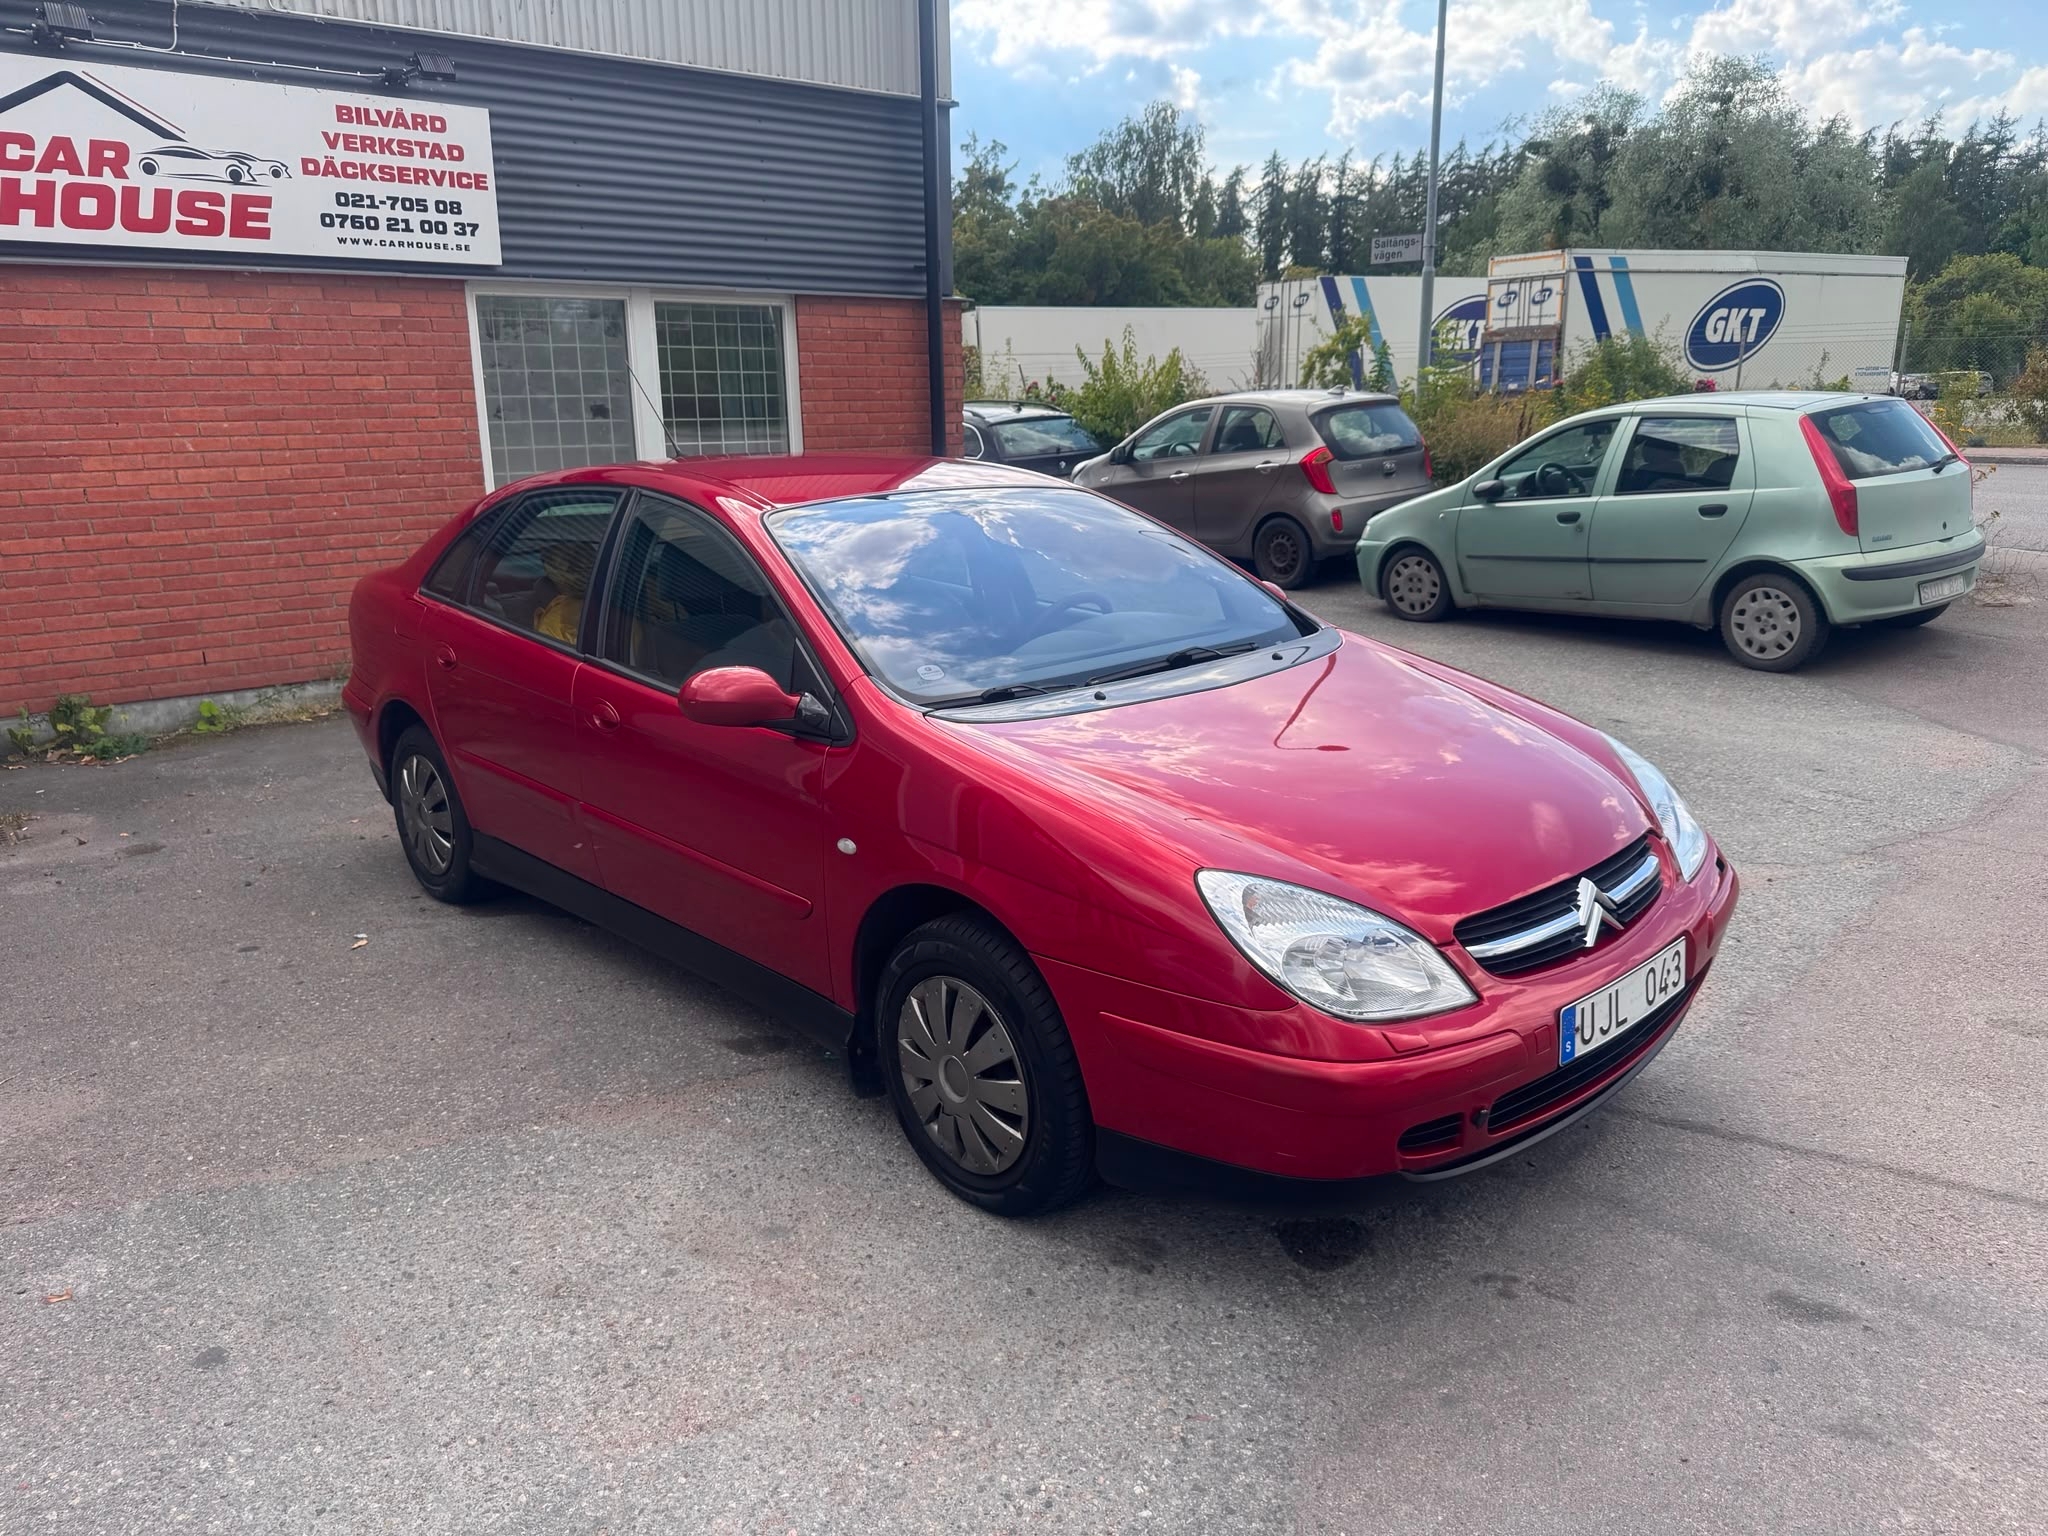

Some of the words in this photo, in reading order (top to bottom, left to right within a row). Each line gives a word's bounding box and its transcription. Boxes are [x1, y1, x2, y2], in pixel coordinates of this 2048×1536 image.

[335, 104, 447, 133] BILVÅRD
[0, 131, 130, 180] CAR
[321, 131, 464, 162] VERKSTAD
[300, 156, 489, 191] DÄCKSERVICE
[0, 177, 272, 240] HOUSE
[335, 192, 428, 213] 021-705
[434, 200, 462, 215] 08
[320, 212, 380, 231] 0760
[386, 217, 414, 233] 21
[419, 219, 448, 235] 00
[453, 222, 480, 237] 37
[337, 236, 471, 251] WWW.CARHOUSE.SE
[1374, 250, 1403, 262] vägen
[1705, 307, 1767, 343] GKT
[1580, 988, 1628, 1045] UJL
[1645, 949, 1682, 1006] 043
[1565, 1041, 1571, 1052] S
